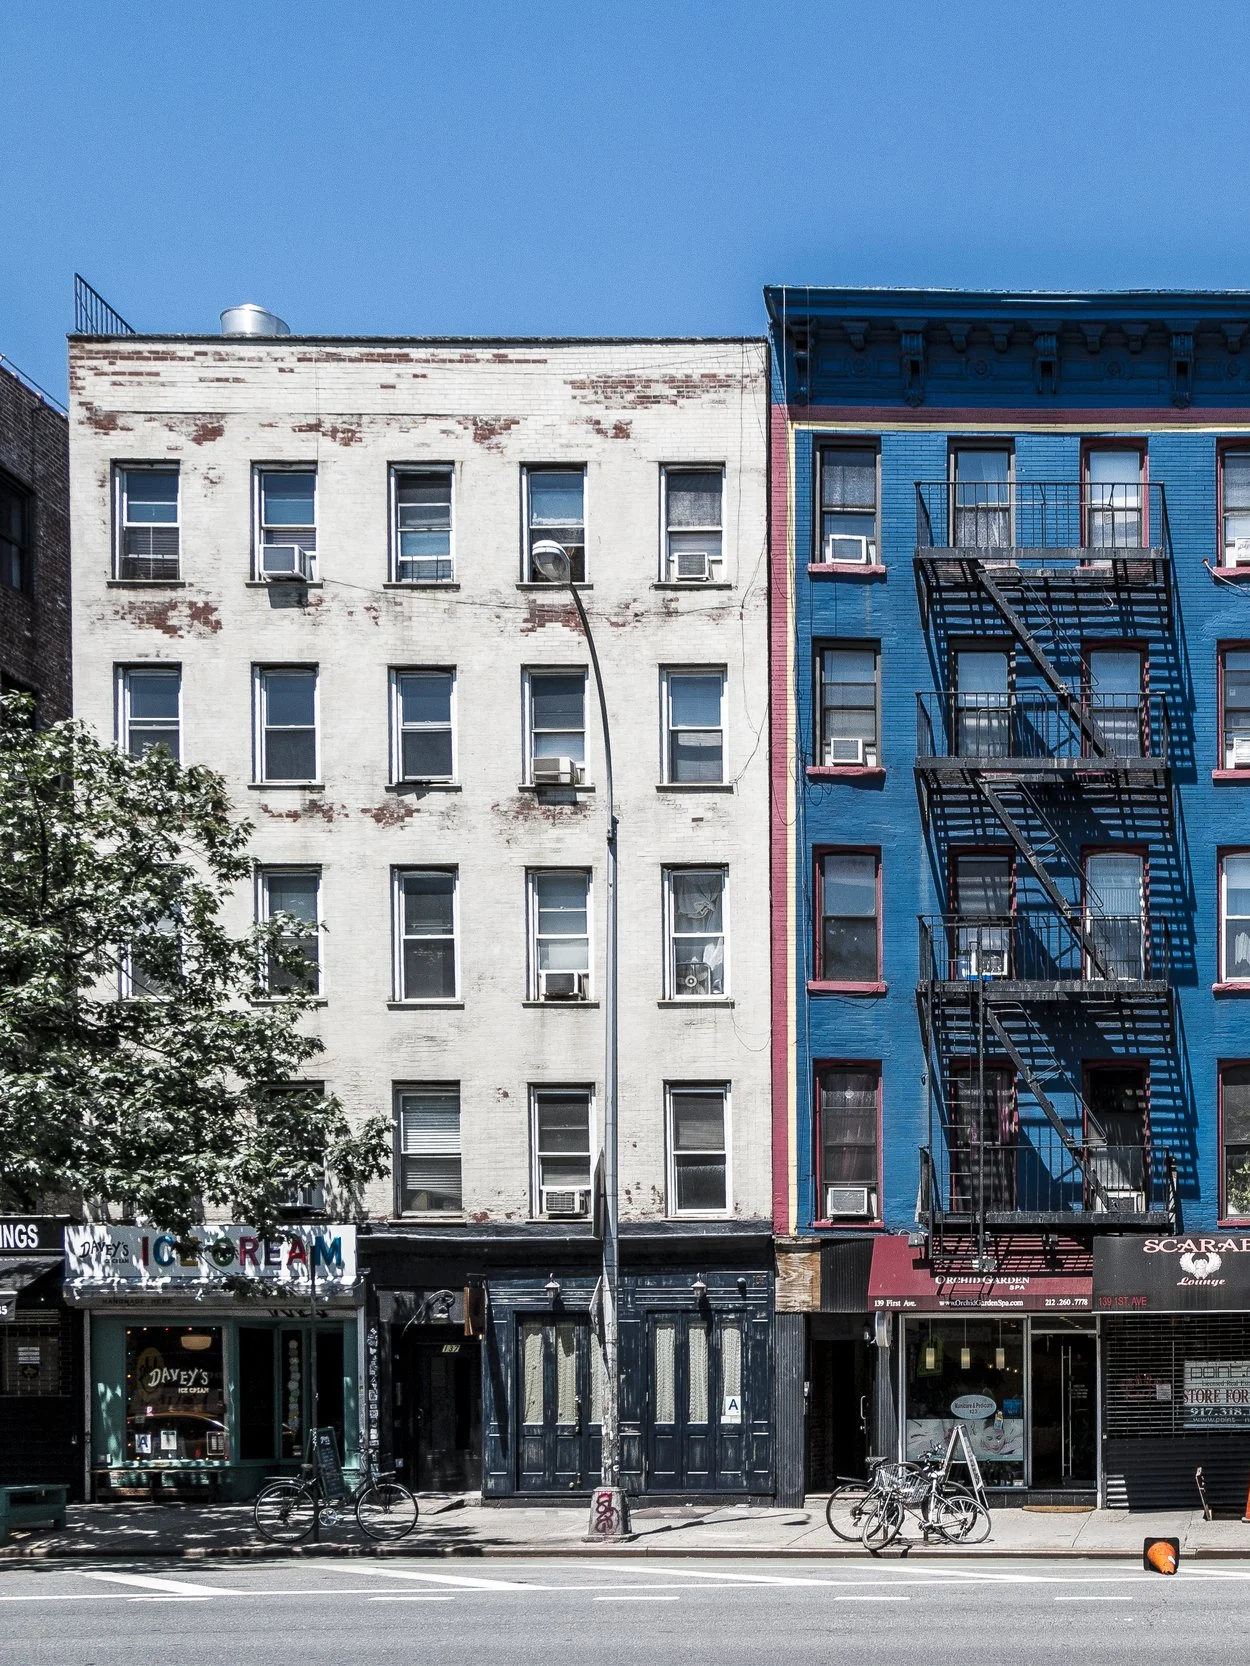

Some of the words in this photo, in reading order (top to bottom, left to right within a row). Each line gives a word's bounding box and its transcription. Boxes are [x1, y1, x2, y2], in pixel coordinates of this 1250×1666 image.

[79, 1241, 130, 1258] DAVEY'S
[211, 1236, 342, 1267] CREAM
[934, 1275, 980, 1285] ORCHID
[981, 1274, 1030, 1286] GARDEN
[1176, 1276, 1226, 1287] Lounge
[874, 1299, 885, 1308] 139
[886, 1298, 902, 1308] First
[903, 1299, 917, 1308] Ave.
[1098, 1297, 1113, 1307] 139
[1131, 1297, 1147, 1306] AVE
[148, 1367, 209, 1387] DAVEY'S
[1183, 1388, 1221, 1404] STORE
[1225, 1388, 1249, 1404] FOR
[728, 1398, 739, 1411] A
